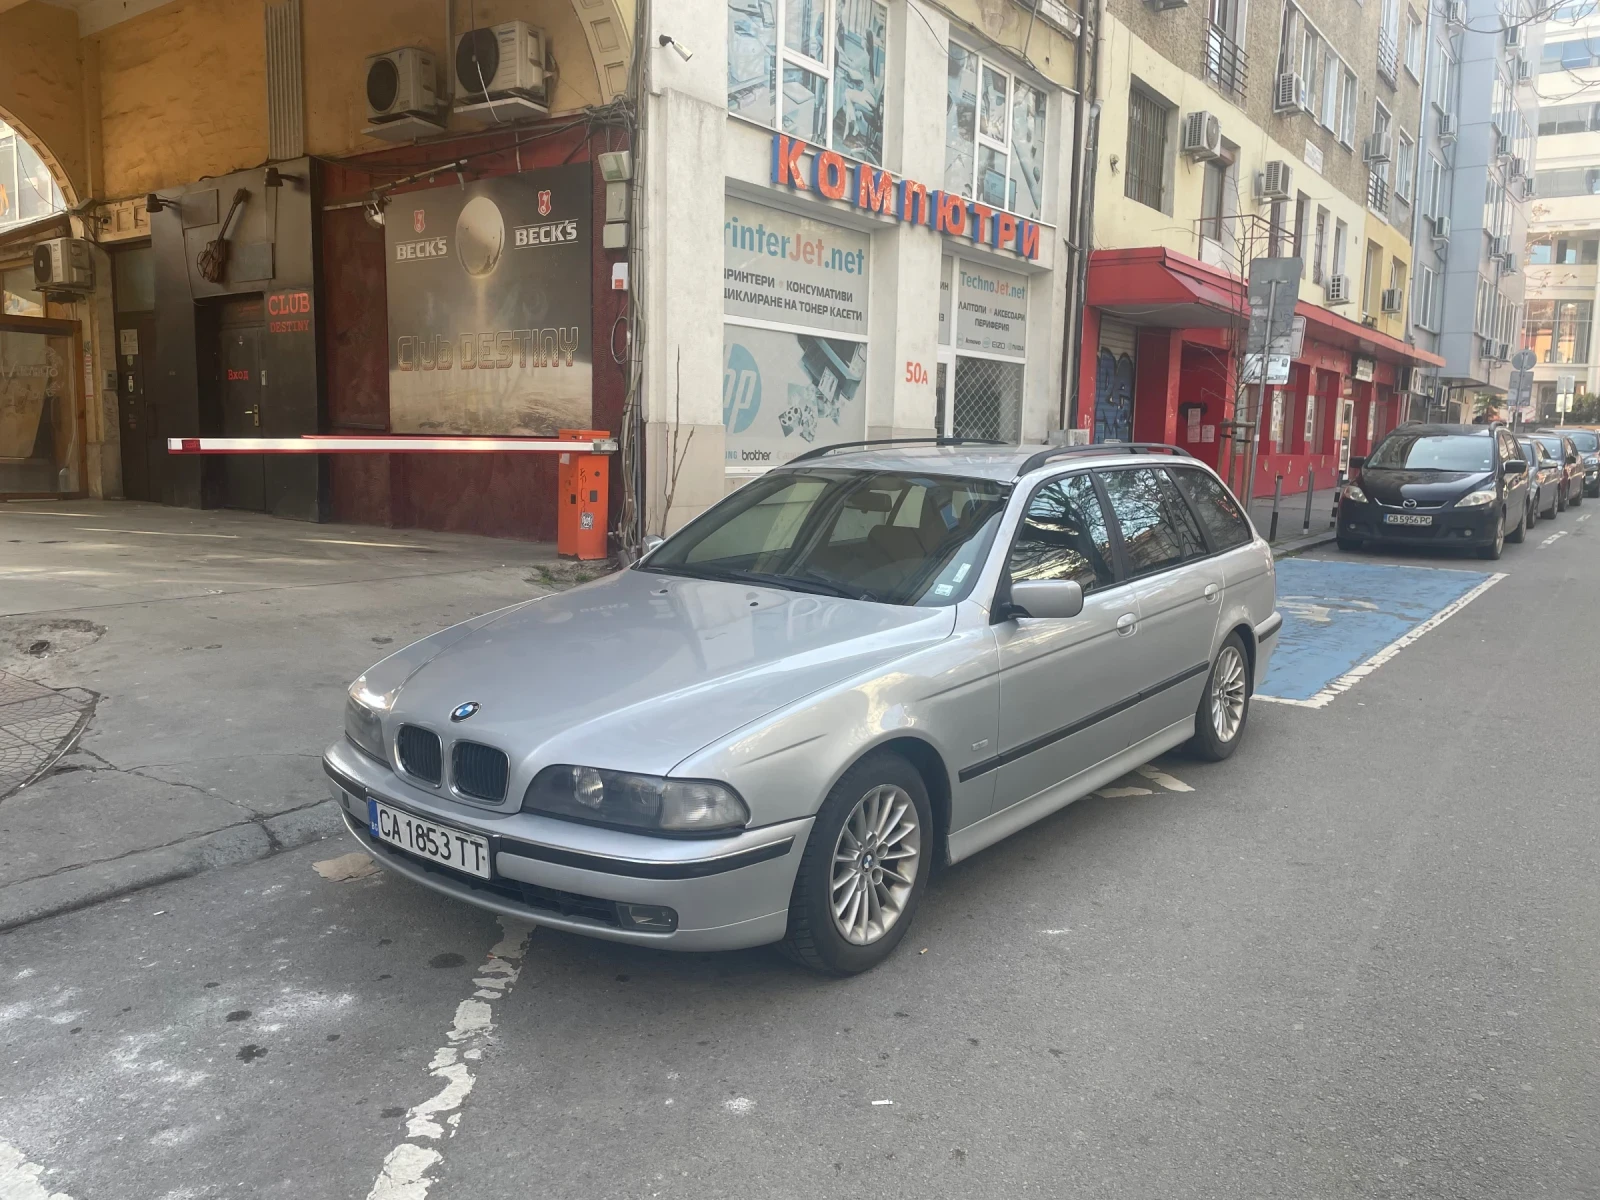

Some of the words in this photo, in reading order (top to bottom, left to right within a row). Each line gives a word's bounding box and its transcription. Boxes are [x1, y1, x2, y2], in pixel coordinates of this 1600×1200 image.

[772, 133, 1040, 260] КОМПЮТРИ
[515, 220, 577, 246] BECK'S
[396, 236, 447, 260] BECK'S
[786, 280, 853, 303] КОНСУМАТИВИ
[960, 271, 1026, 300] TechnoJet.net
[268, 292, 310, 316] CLUB
[784, 298, 798, 311] НА
[799, 300, 829, 316] ТОНЕР
[829, 306, 863, 322] КАСЕТИ
[958, 301, 987, 315] ЛАПТОПИ
[270, 320, 309, 333] DESTINY
[974, 318, 1010, 332] ПЕРИФЕРИЯ
[460, 327, 579, 370] DESTINY
[992, 341, 1005, 350] EIZO
[228, 369, 249, 381] Вход
[742, 449, 771, 461] brother
[1399, 515, 1419, 525] 5956
[380, 808, 402, 843] CA
[406, 819, 451, 860] 1853
[455, 835, 483, 871] TT
